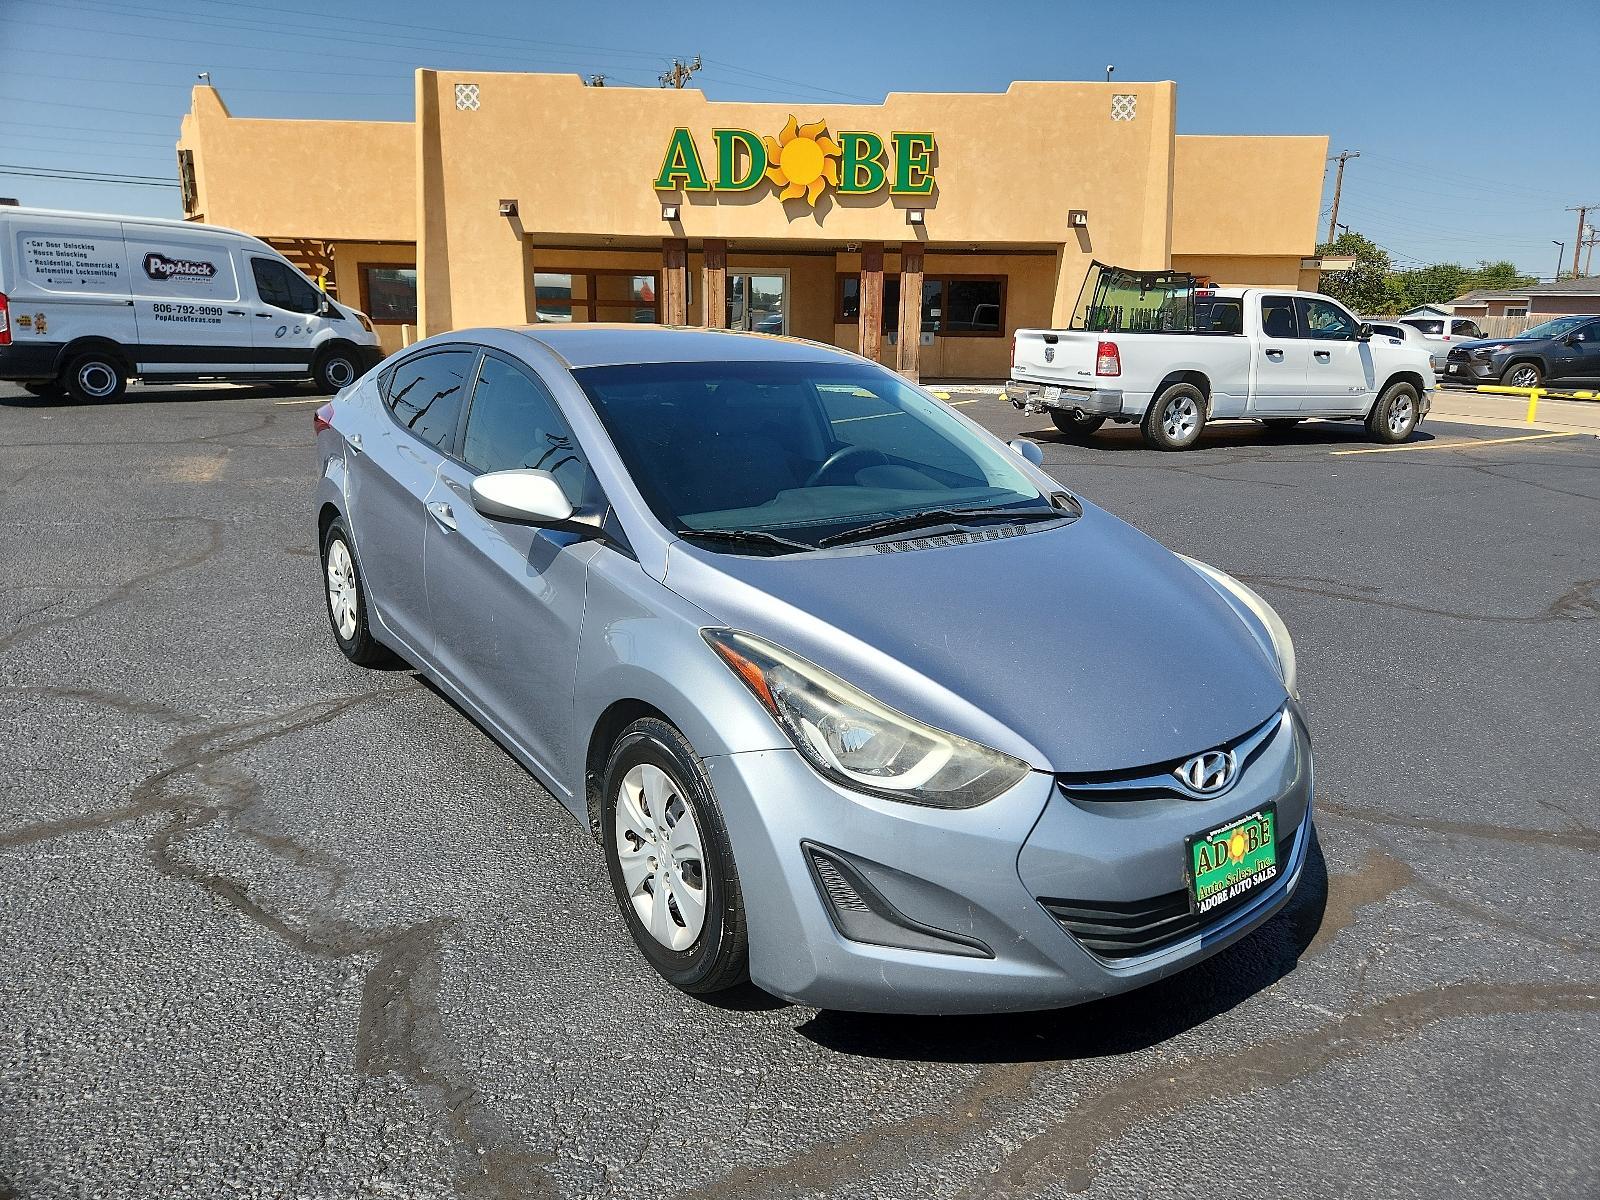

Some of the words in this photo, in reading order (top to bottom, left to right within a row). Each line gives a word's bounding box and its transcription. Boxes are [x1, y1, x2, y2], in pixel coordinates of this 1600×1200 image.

[63, 242, 95, 251] Unlocking
[55, 250, 87, 259] Unlocking
[76, 261, 113, 269] Commercial
[36, 266, 74, 274] Automotive
[75, 268, 117, 278] Locksmithing
[153, 304, 222, 316] 806-792-9090
[155, 314, 221, 324] PopALockTexas.com
[1199, 880, 1224, 900] Auto
[1255, 857, 1273, 872] Inc.
[1199, 889, 1229, 914] ADOBE
[1229, 877, 1252, 899] AUTO
[1252, 865, 1277, 886] SALES
